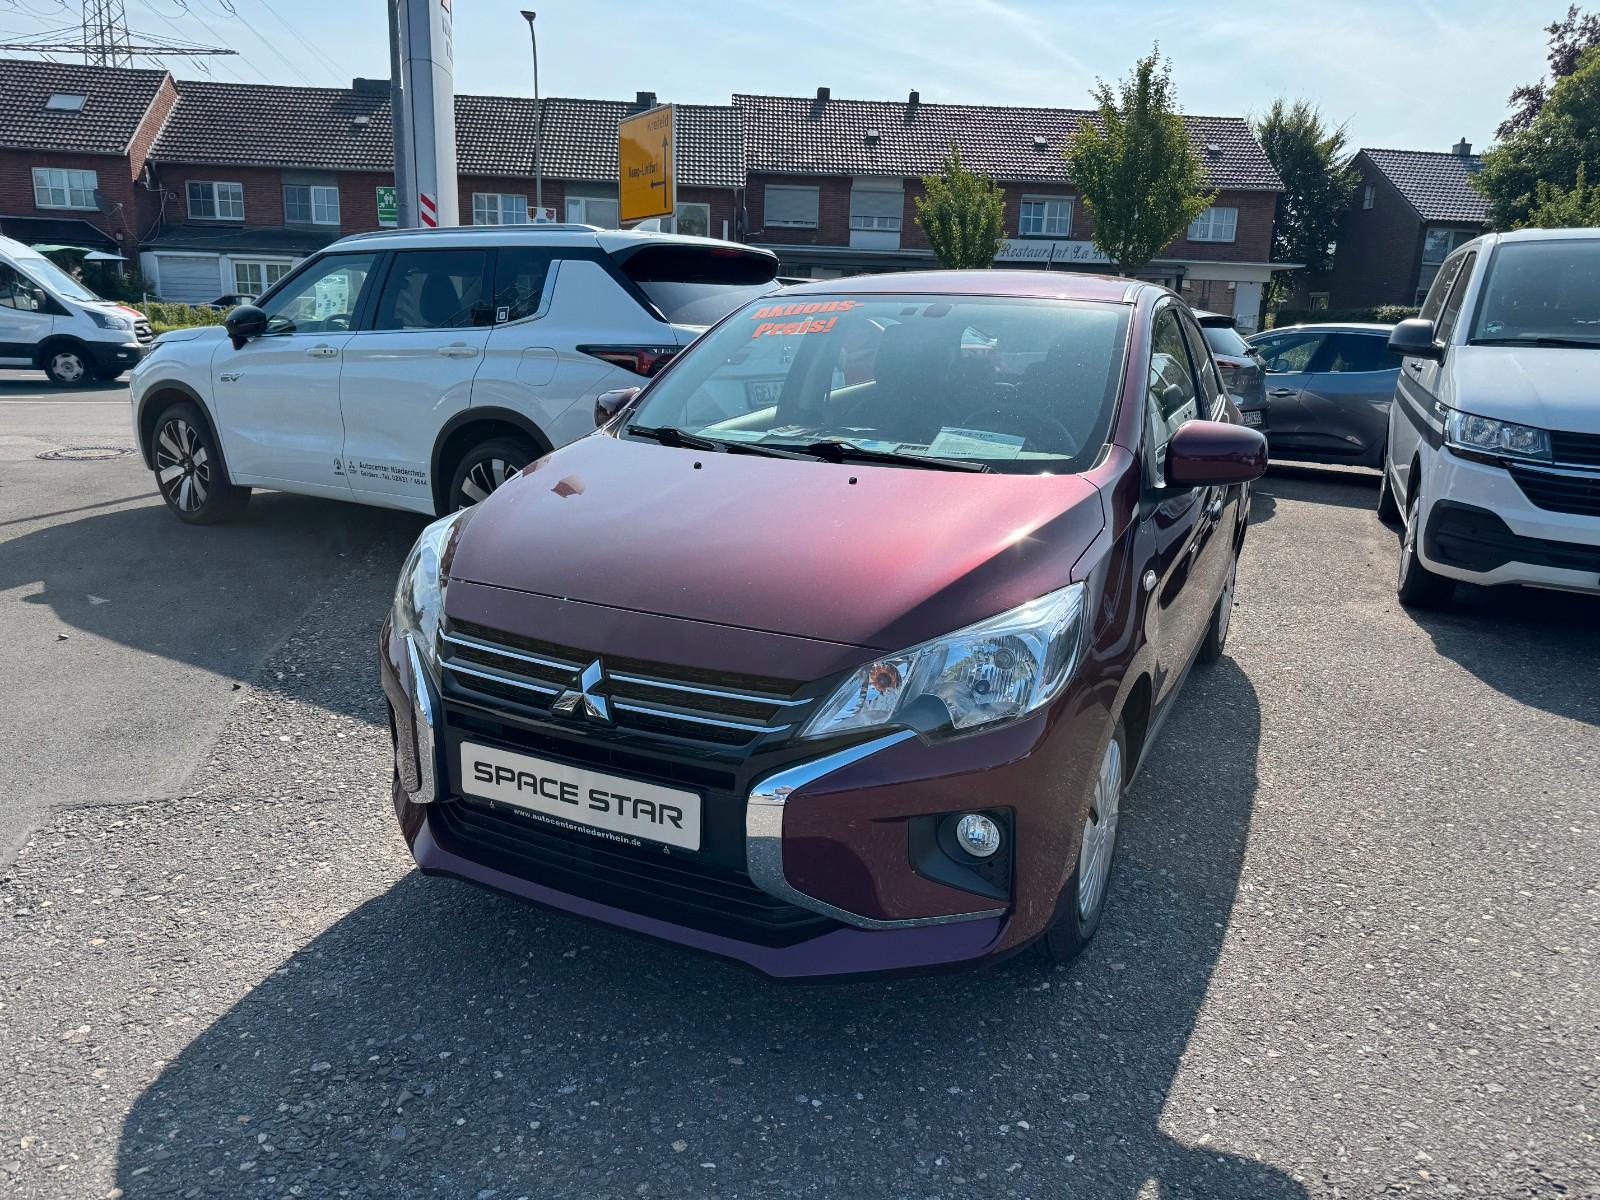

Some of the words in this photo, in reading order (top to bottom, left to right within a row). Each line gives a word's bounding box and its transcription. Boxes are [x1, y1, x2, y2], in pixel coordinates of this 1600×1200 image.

[648, 115, 669, 130] Krefeld
[1001, 243, 1068, 258] Restaurant
[752, 317, 839, 337] Preis!
[359, 461, 389, 472] Autocenter
[390, 466, 425, 477] Niederrhein
[473, 760, 579, 805] SPACE
[588, 789, 684, 830] STAR
[513, 808, 642, 846] www.autocenterniederrhein.de
